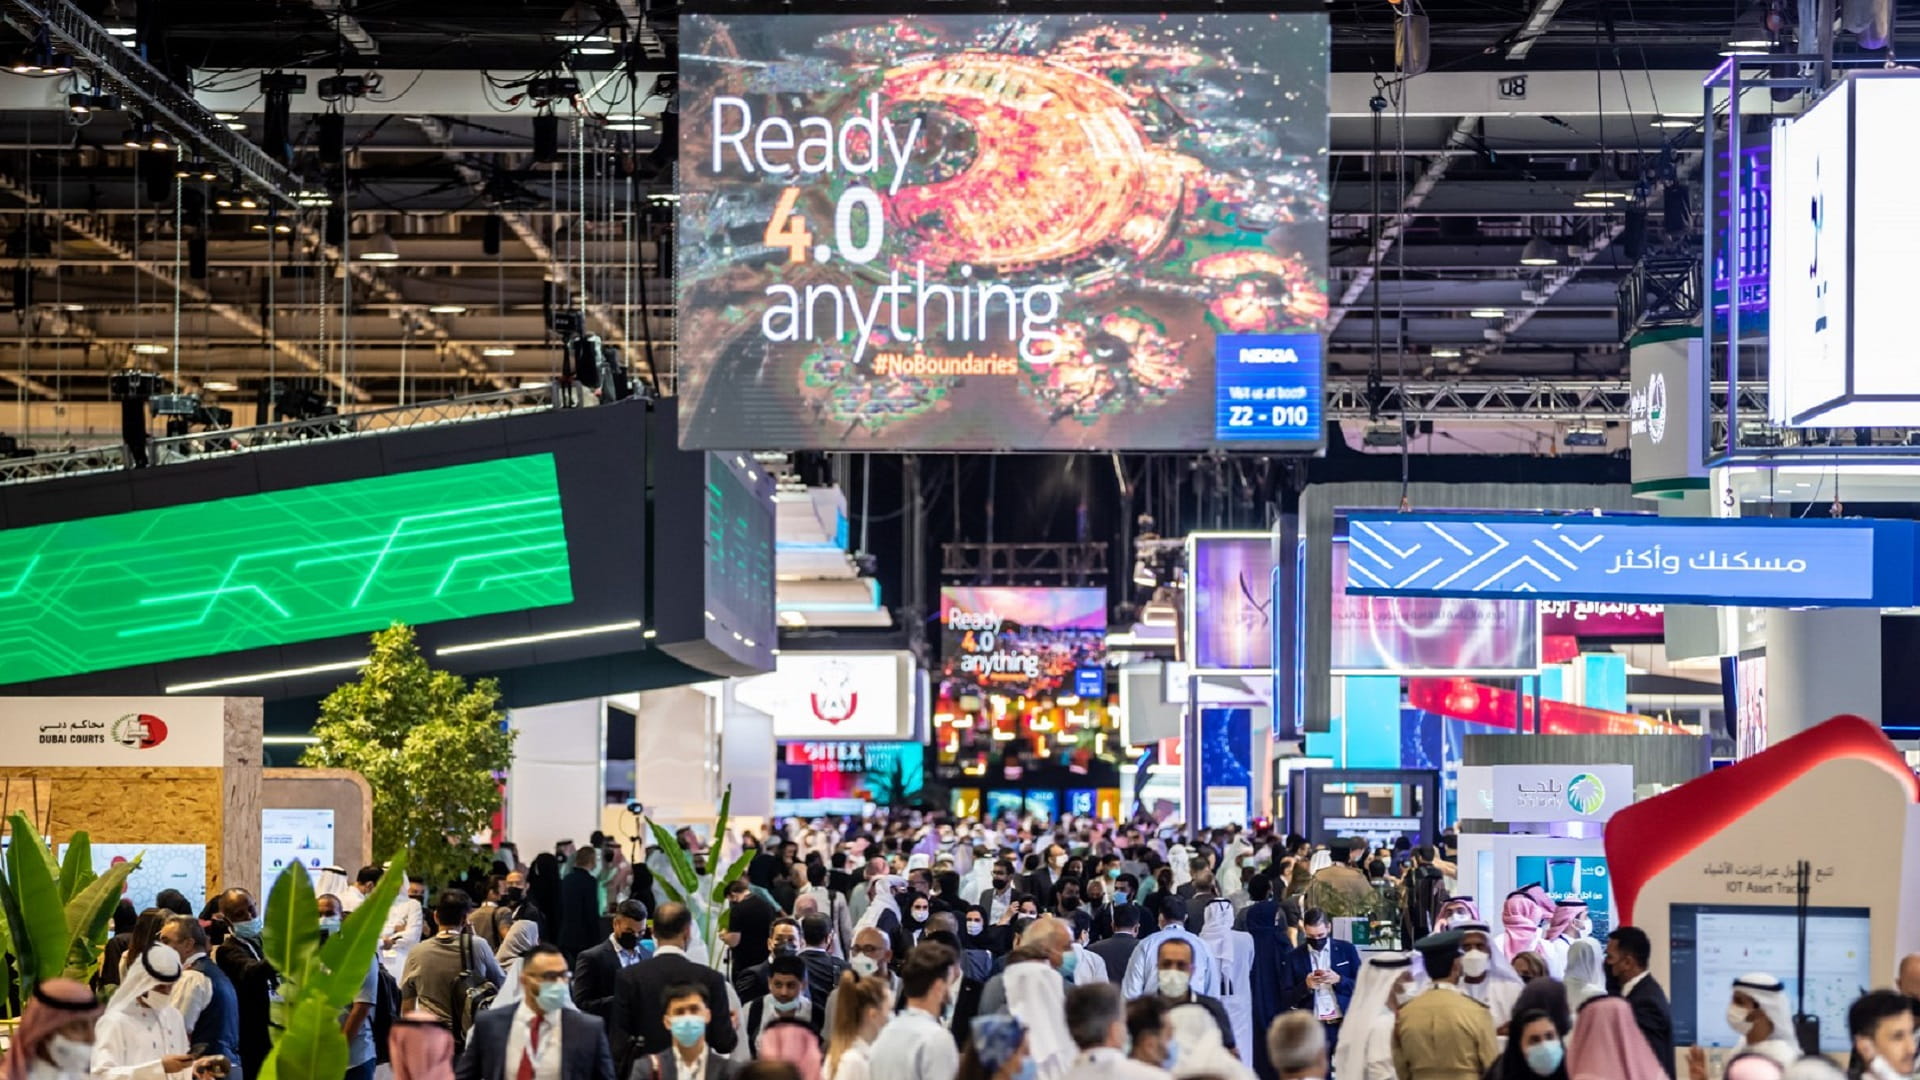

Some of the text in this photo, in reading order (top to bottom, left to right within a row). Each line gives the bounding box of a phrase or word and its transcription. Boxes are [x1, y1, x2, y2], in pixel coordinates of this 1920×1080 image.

[711, 93, 924, 195] Ready
[763, 186, 884, 264] 4.0
[761, 260, 1065, 365] anything
[873, 351, 1018, 375] #NoBoundaries
[1228, 405, 1254, 427] Z2
[1272, 405, 1309, 427] D10
[1605, 544, 1807, 575] مسكنك وأكثر
[948, 607, 1004, 635] Ready
[961, 630, 995, 653] 4.0
[960, 649, 1039, 678] anything
[39, 735, 105, 744] DUBAI COURTS
[1746, 881, 1774, 893] Asset
